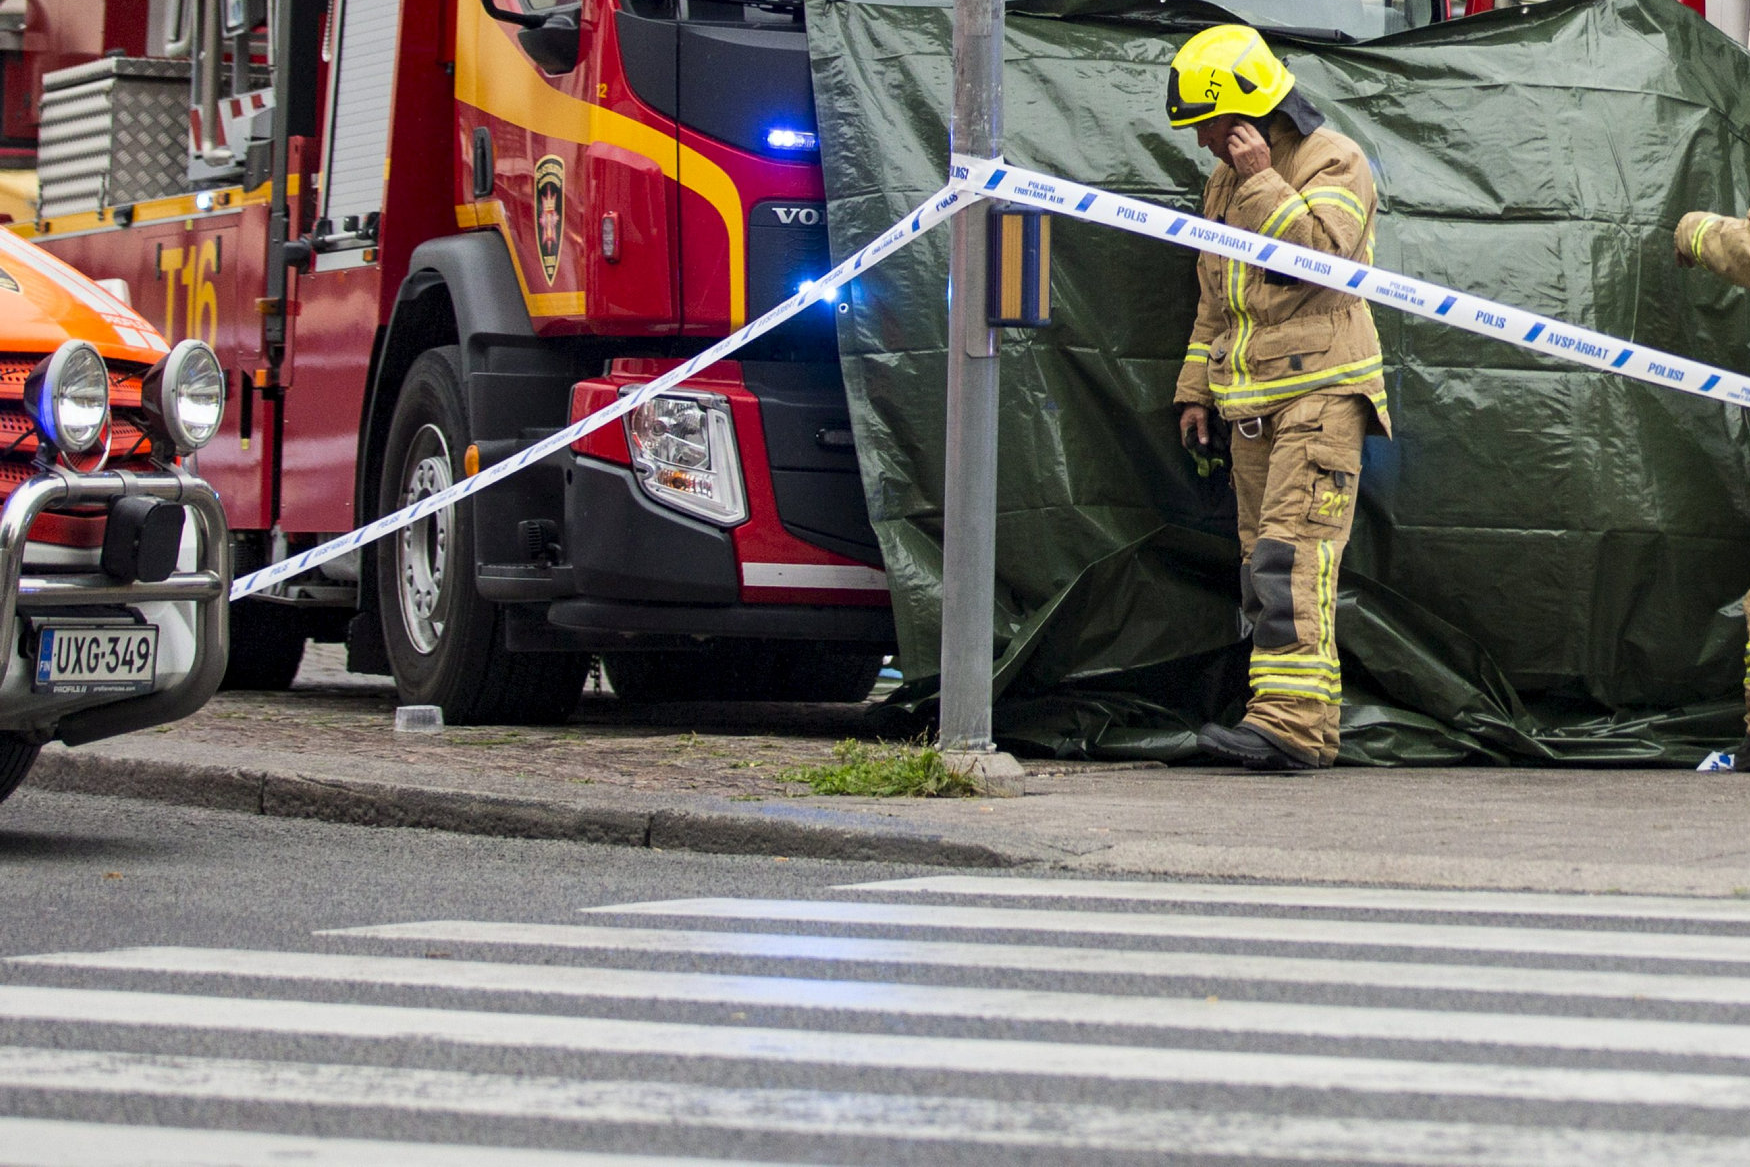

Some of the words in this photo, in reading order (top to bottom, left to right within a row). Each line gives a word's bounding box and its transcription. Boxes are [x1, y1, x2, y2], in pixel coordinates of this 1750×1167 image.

[772, 206, 823, 226] VO
[1115, 205, 1149, 224] POLIS
[1293, 254, 1333, 276] POLIISI
[160, 239, 219, 352] T16
[1474, 308, 1507, 329] POLIS
[1546, 331, 1610, 361] AVSPÄRRAT
[1647, 361, 1686, 382] POLIISI
[57, 636, 150, 674] UXG-349
[40, 660, 52, 673] FIN
